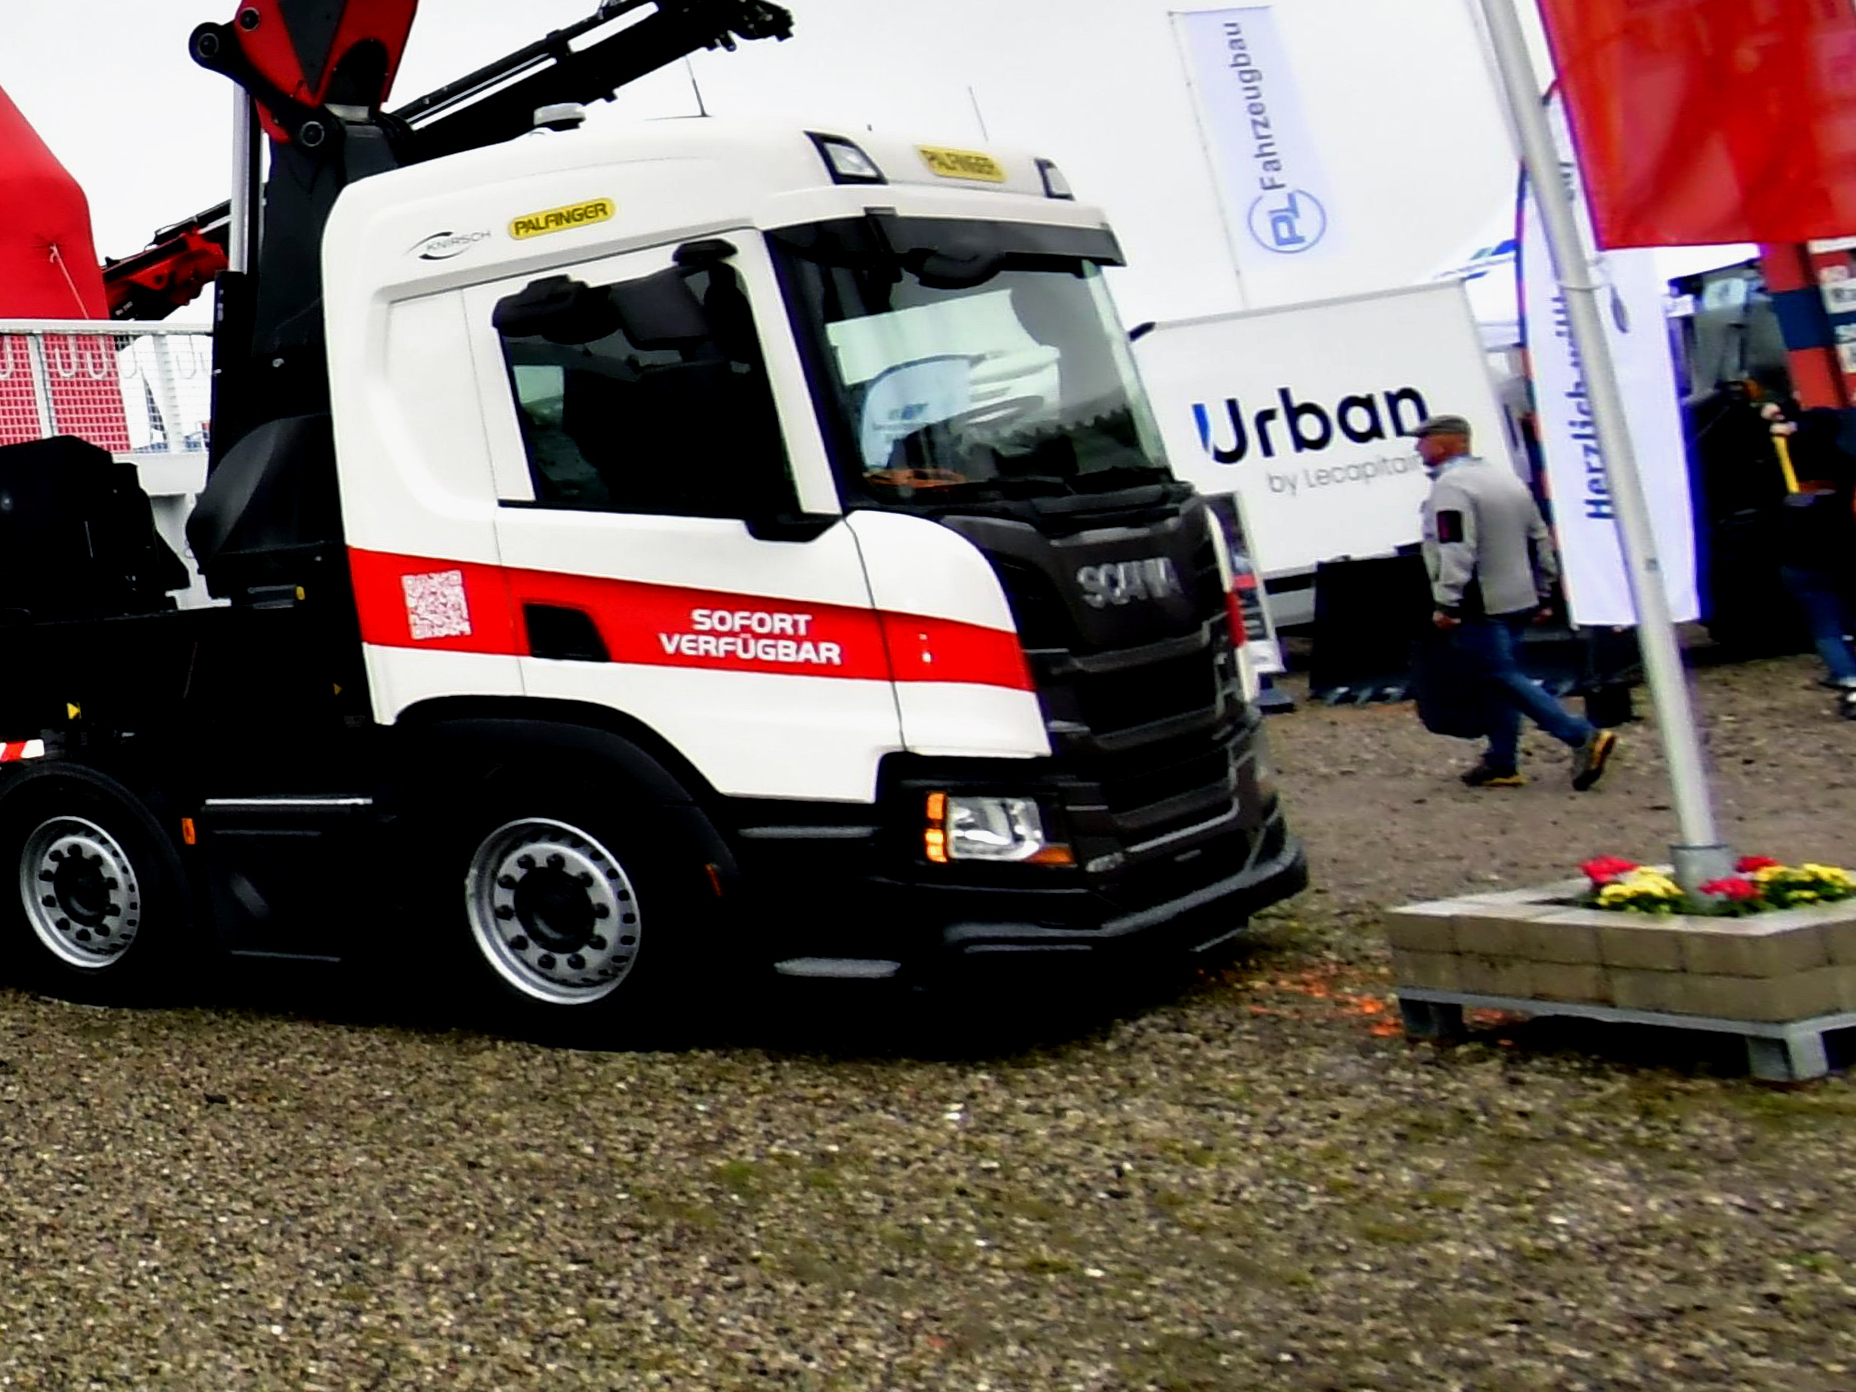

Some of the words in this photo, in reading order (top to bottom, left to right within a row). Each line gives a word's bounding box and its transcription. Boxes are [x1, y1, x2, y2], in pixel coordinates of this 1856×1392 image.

[1223, 22, 1286, 191] Fahrzeugbau
[514, 202, 609, 236] PALFINGER
[1192, 386, 1429, 464] Urban
[1267, 472, 1298, 495] by
[690, 608, 813, 636] SOFORT
[658, 633, 841, 666] VERFÜGBAR
